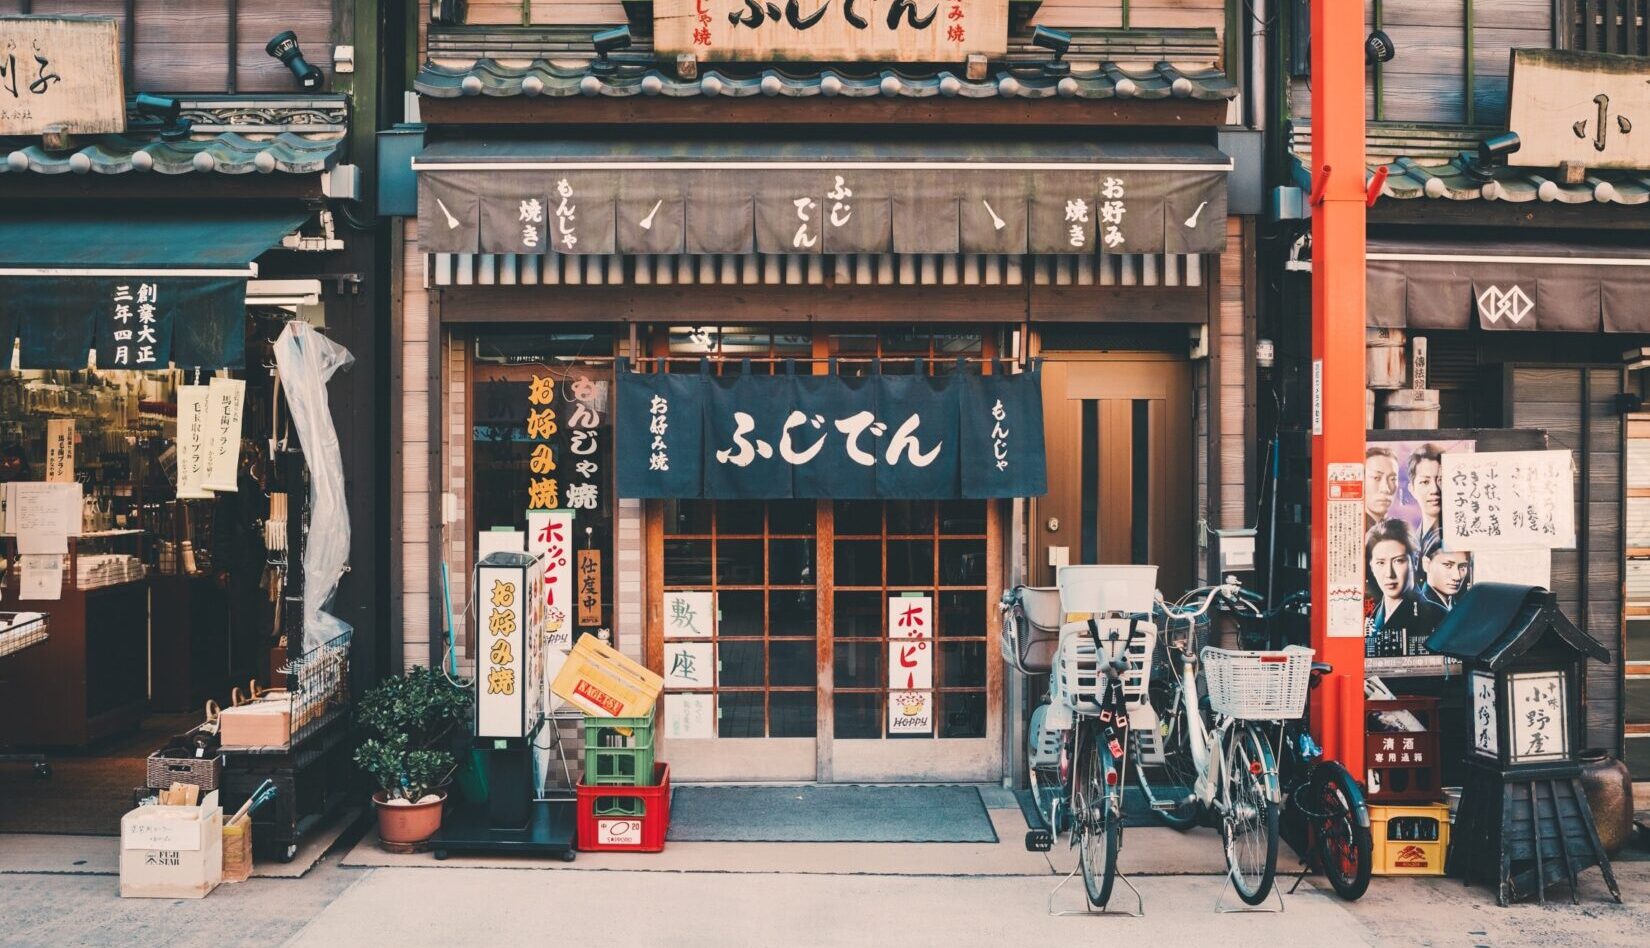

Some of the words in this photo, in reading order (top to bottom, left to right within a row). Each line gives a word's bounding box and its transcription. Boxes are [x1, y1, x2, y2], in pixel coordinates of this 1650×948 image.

[946, 0, 966, 43] み焼
[1572, 93, 1632, 152] 小
[519, 199, 543, 247] 焼き
[556, 178, 578, 250] もんじゃ
[793, 198, 818, 248] でん
[827, 175, 853, 227] ふじ
[1065, 200, 1089, 248] 焼き
[1100, 176, 1127, 248] お好み
[113, 285, 134, 364] 三年四月
[136, 283, 158, 363] 創業大正
[526, 373, 559, 510] お好み焼
[648, 394, 670, 472] お好み焼
[715, 410, 943, 468] ふじでん
[990, 398, 1009, 473] もんじゃ
[538, 518, 567, 606] ホッピー
[580, 556, 598, 613] 仕度中
[488, 579, 516, 696] お好み焼
[670, 650, 699, 682] 座
[898, 602, 926, 690] ホッピー
[1383, 738, 1414, 750] 清酒
[1525, 686, 1550, 755] 小野屋
[631, 823, 640, 831] 20
